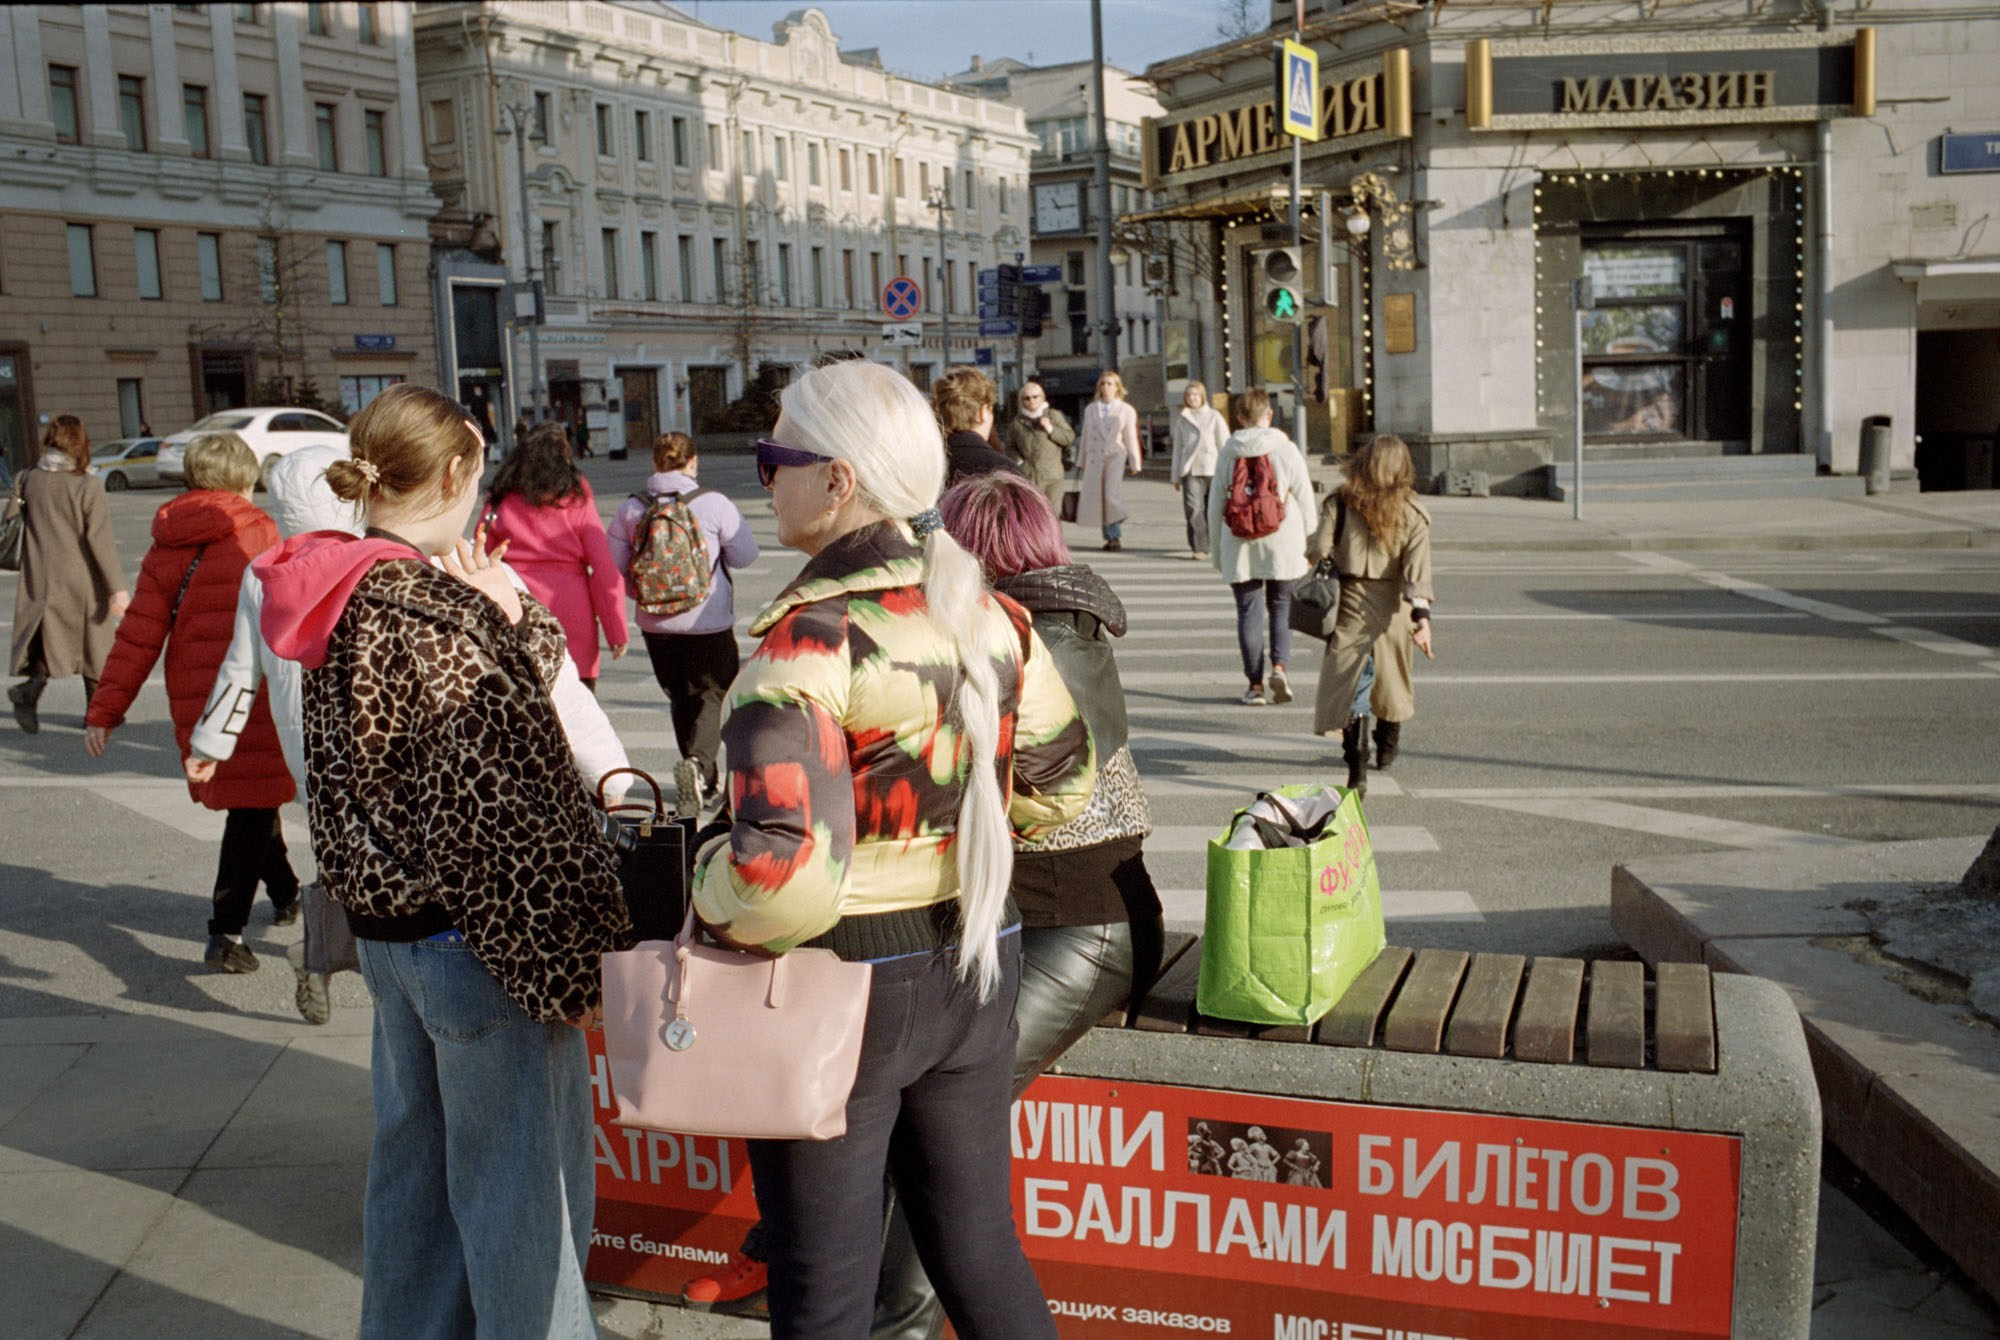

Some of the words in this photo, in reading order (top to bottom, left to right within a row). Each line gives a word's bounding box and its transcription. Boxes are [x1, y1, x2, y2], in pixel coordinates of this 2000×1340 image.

[1168, 75, 1379, 173] АРМЕИЯ
[1561, 70, 1777, 113] МАГАЗИН
[1358, 1133, 1681, 1222] БИЛЕТОВ
[629, 1233, 729, 1265] баллами
[1121, 1307, 1232, 1333] заказов
[1024, 1177, 1347, 1270] БАЛЛАМИ
[1372, 1213, 1682, 1305] МОСБИЛЕТ
